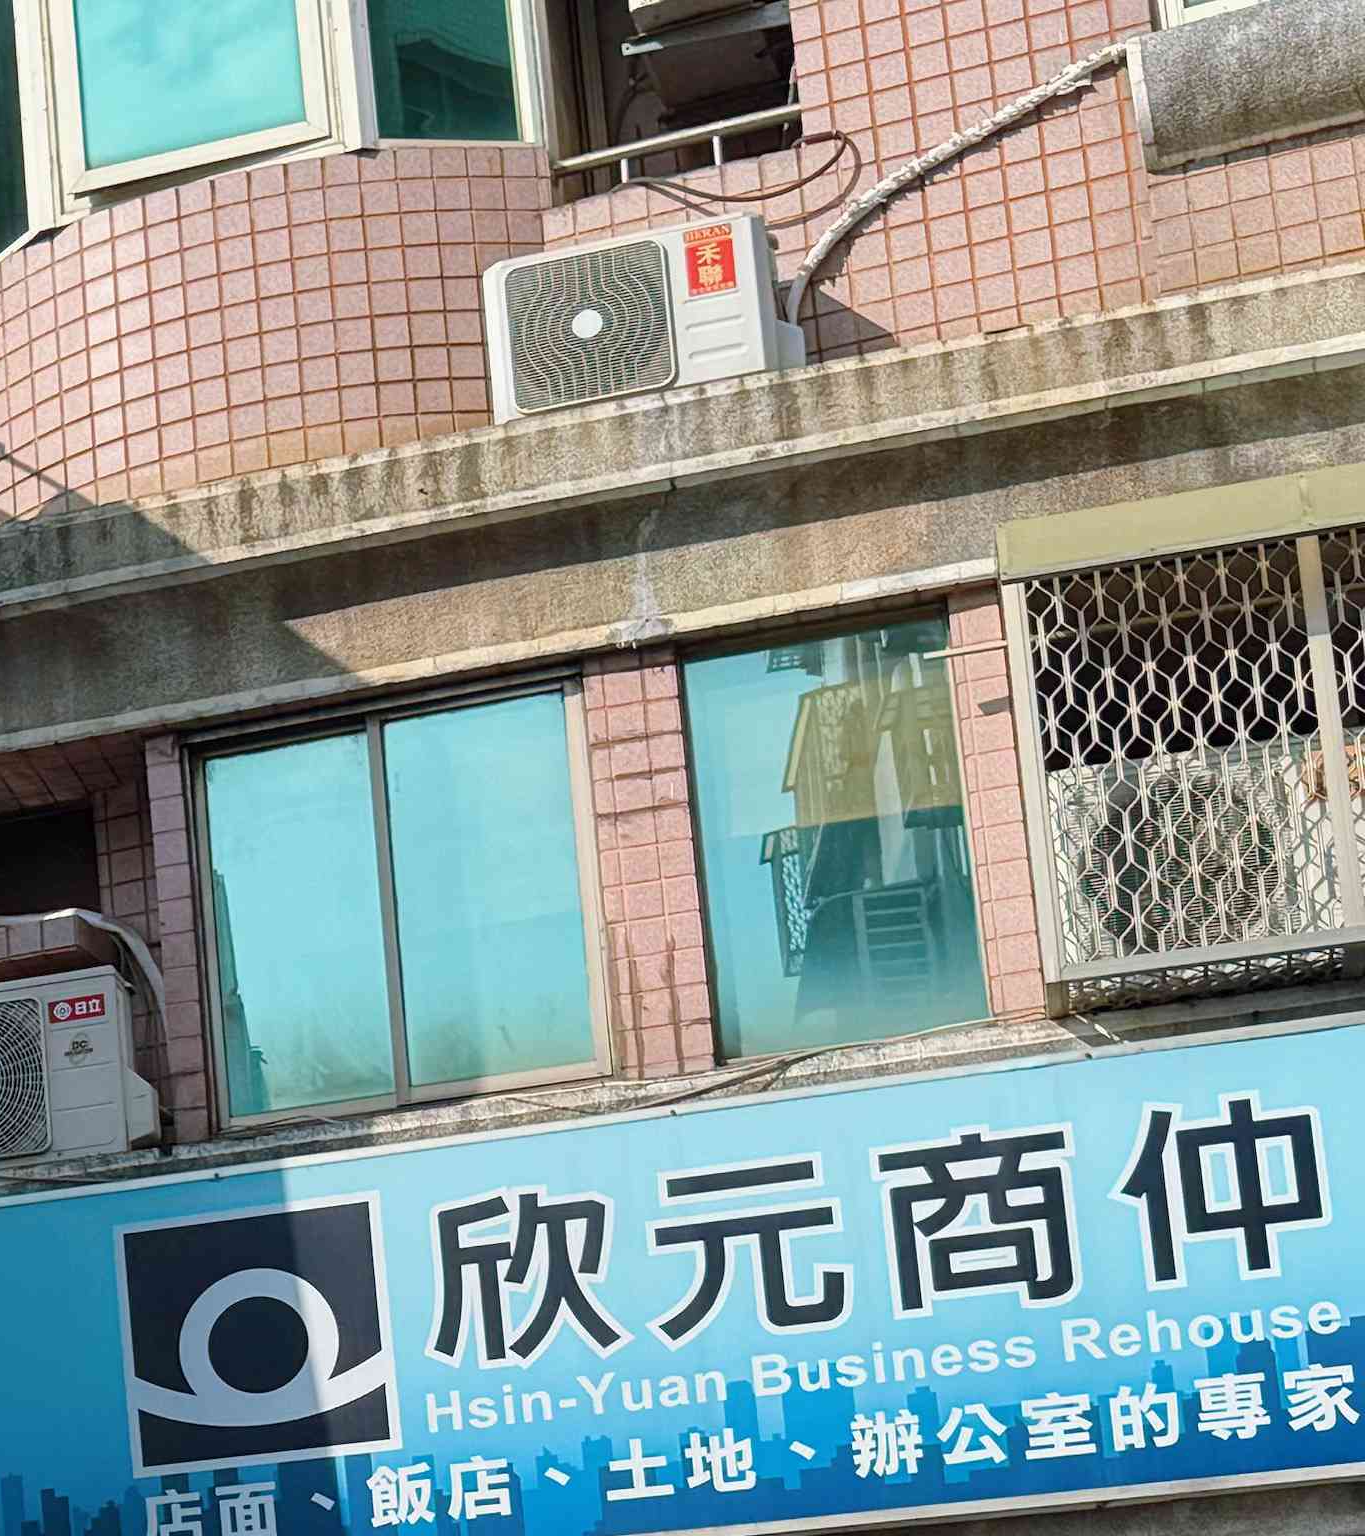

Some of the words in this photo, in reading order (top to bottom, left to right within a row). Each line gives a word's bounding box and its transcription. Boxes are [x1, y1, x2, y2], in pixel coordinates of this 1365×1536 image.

[695, 243, 724, 287] 禾聯
[75, 998, 102, 1015] 日立
[429, 1094, 1330, 1365] 欣元商仲
[426, 1370, 728, 1433] Hsin-Yuan
[753, 1331, 1037, 1398] Business
[1060, 1299, 1343, 1363] Rehouse
